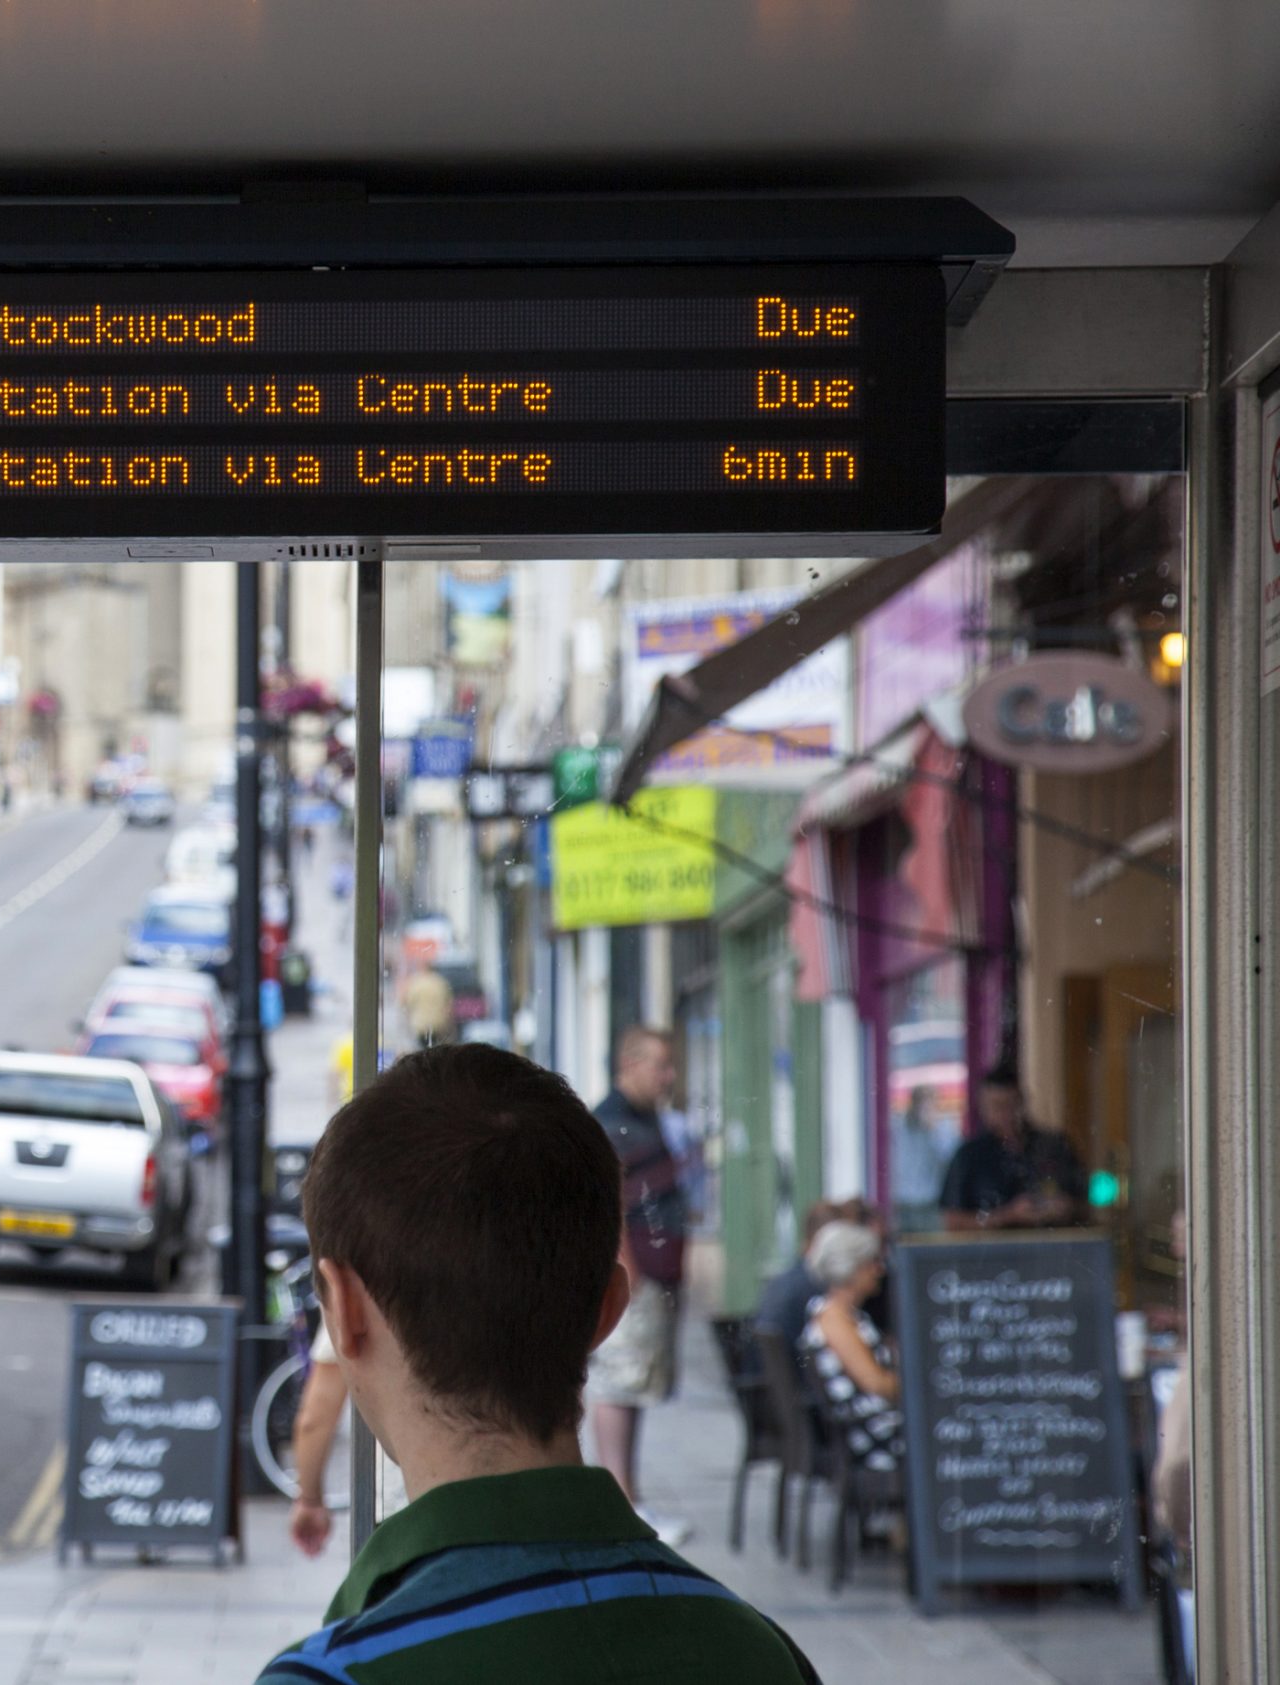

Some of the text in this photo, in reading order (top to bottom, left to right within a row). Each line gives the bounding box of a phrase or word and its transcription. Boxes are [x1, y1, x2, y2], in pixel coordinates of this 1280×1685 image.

[757, 297, 855, 338] Due
[226, 376, 320, 414] via
[357, 373, 552, 413] Centre
[757, 369, 854, 409] Due
[226, 452, 320, 485] via
[357, 448, 552, 485] Centre
[723, 445, 855, 481] 6min
